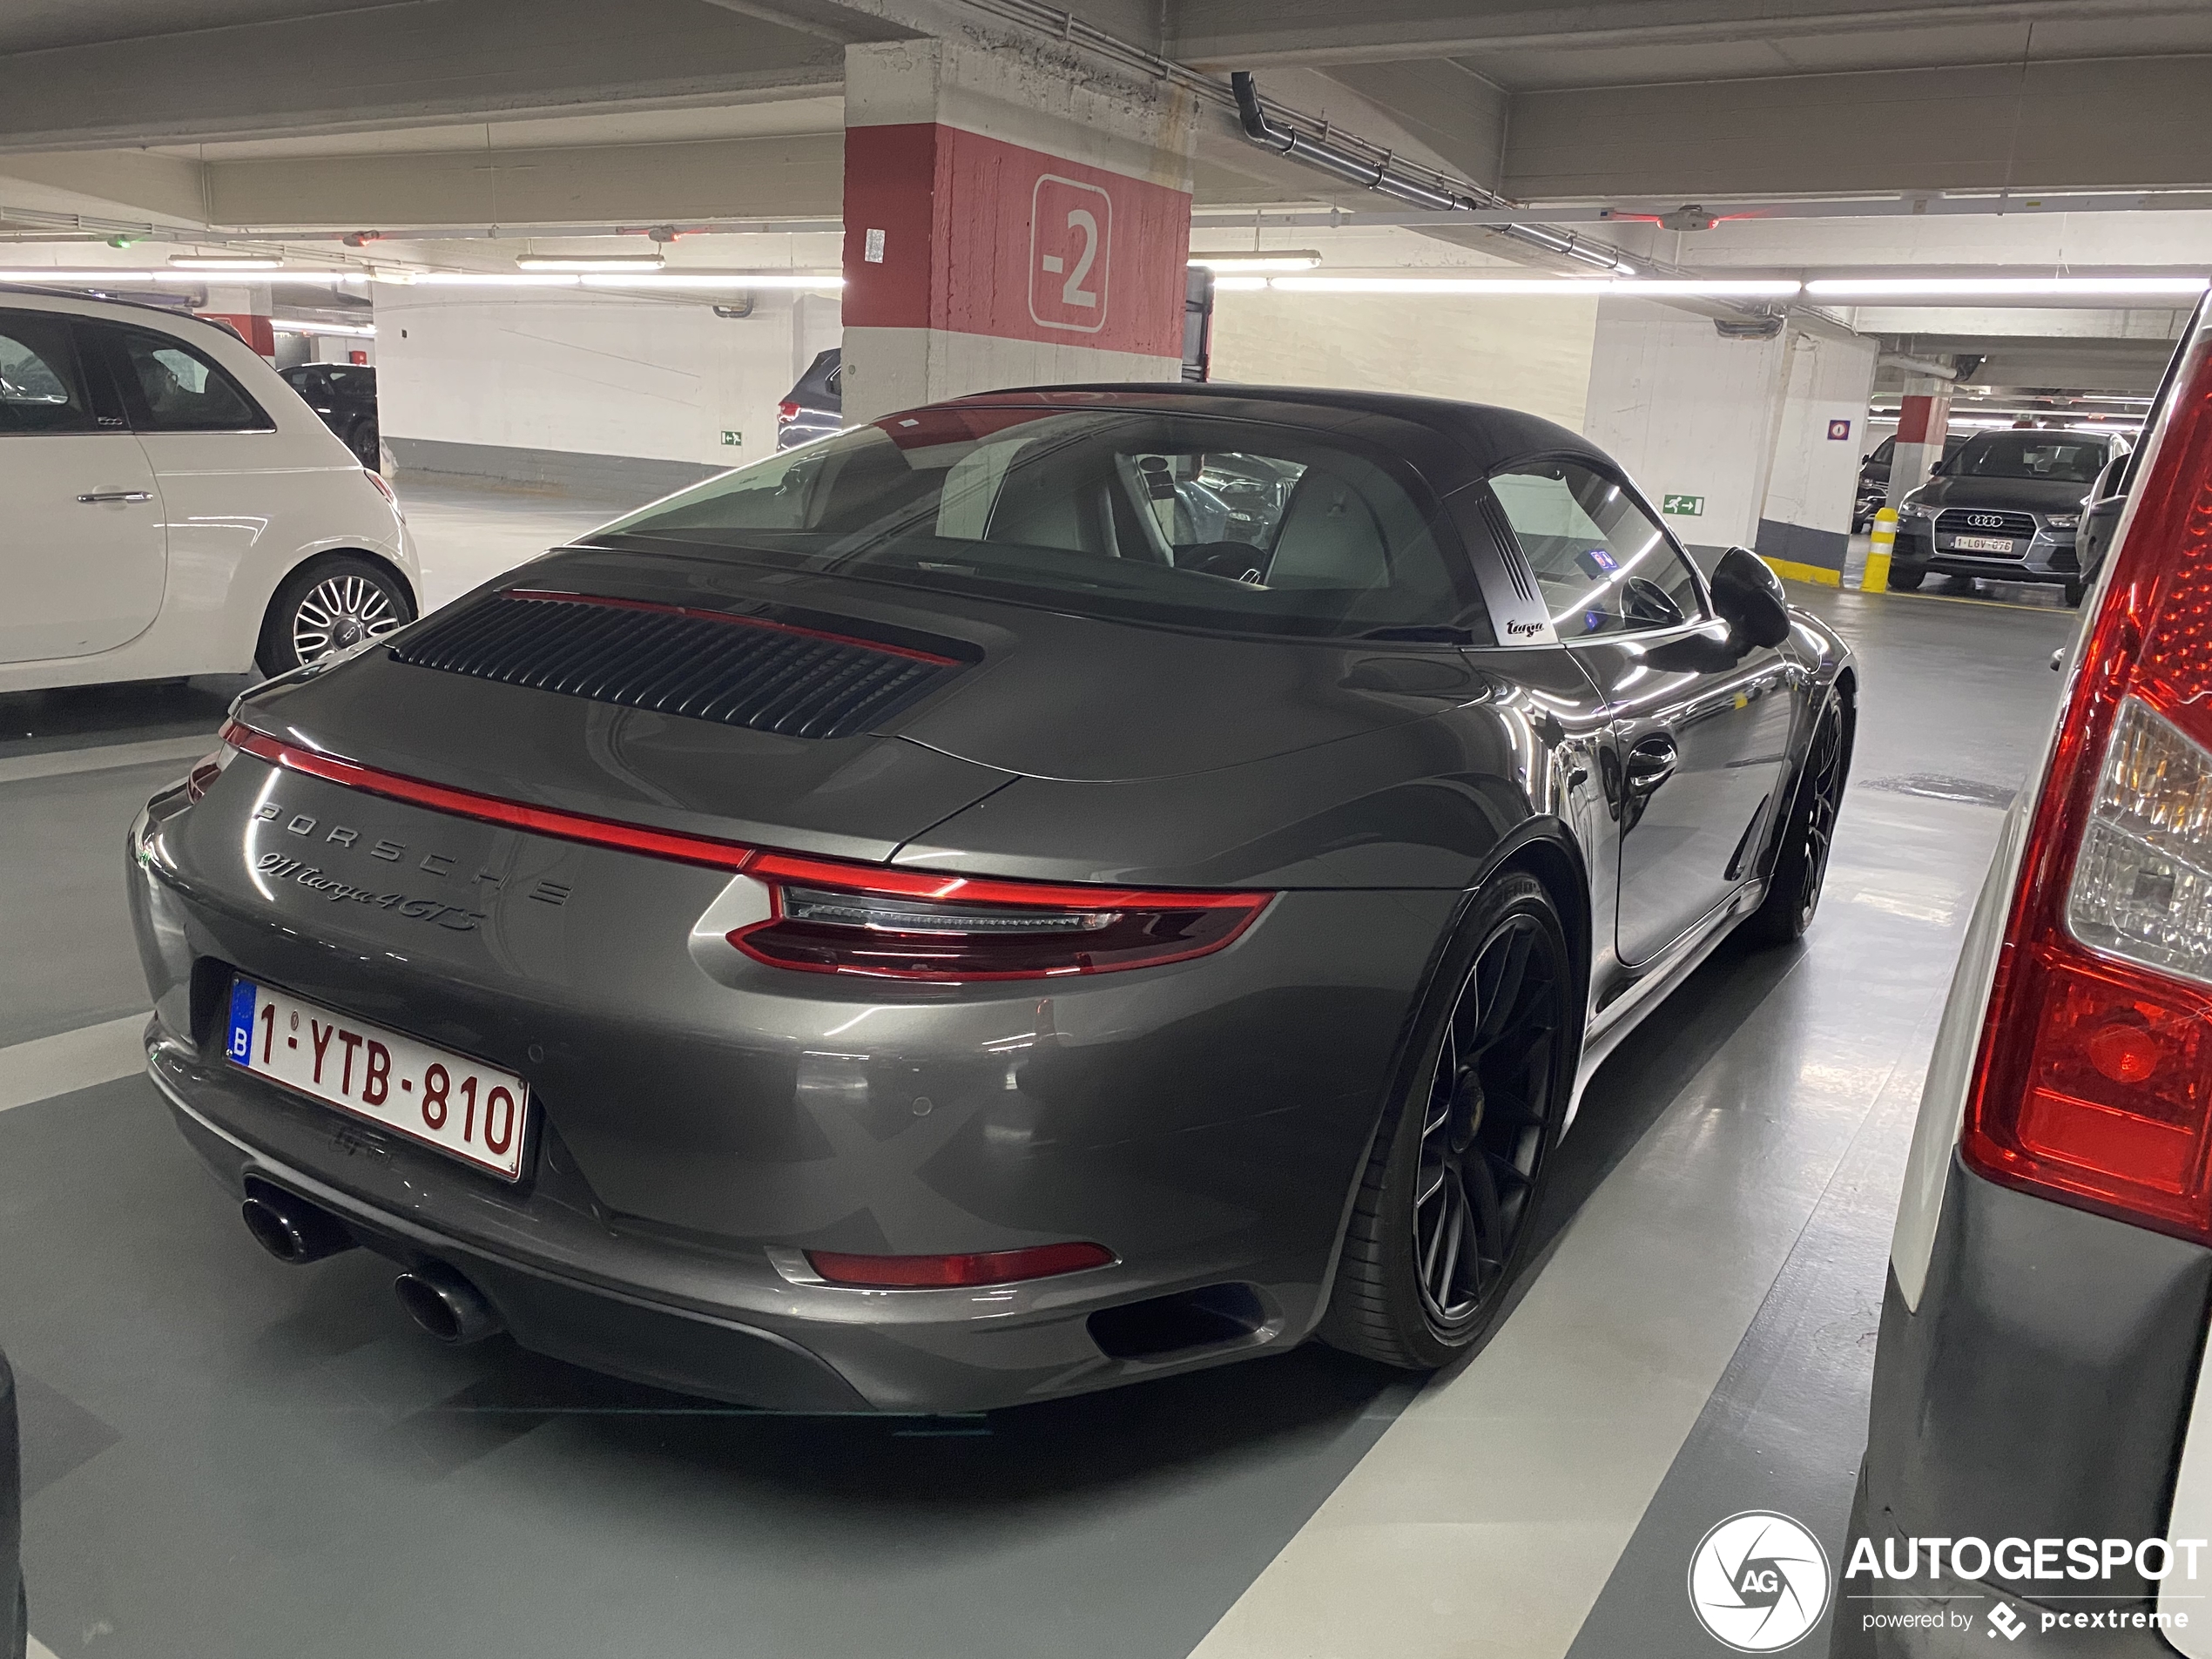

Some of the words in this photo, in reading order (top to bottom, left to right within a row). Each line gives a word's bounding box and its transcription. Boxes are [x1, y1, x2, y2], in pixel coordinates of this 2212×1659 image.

[1042, 209, 1098, 307] -2
[1507, 619, 1544, 637] targa
[253, 802, 573, 906] PORSCHE
[256, 853, 303, 878] 911
[297, 867, 373, 901] targa
[374, 893, 403, 909] 4
[398, 899, 488, 931] GTS
[233, 1028, 247, 1057] B
[261, 1002, 515, 1155] 1-YTB-810
